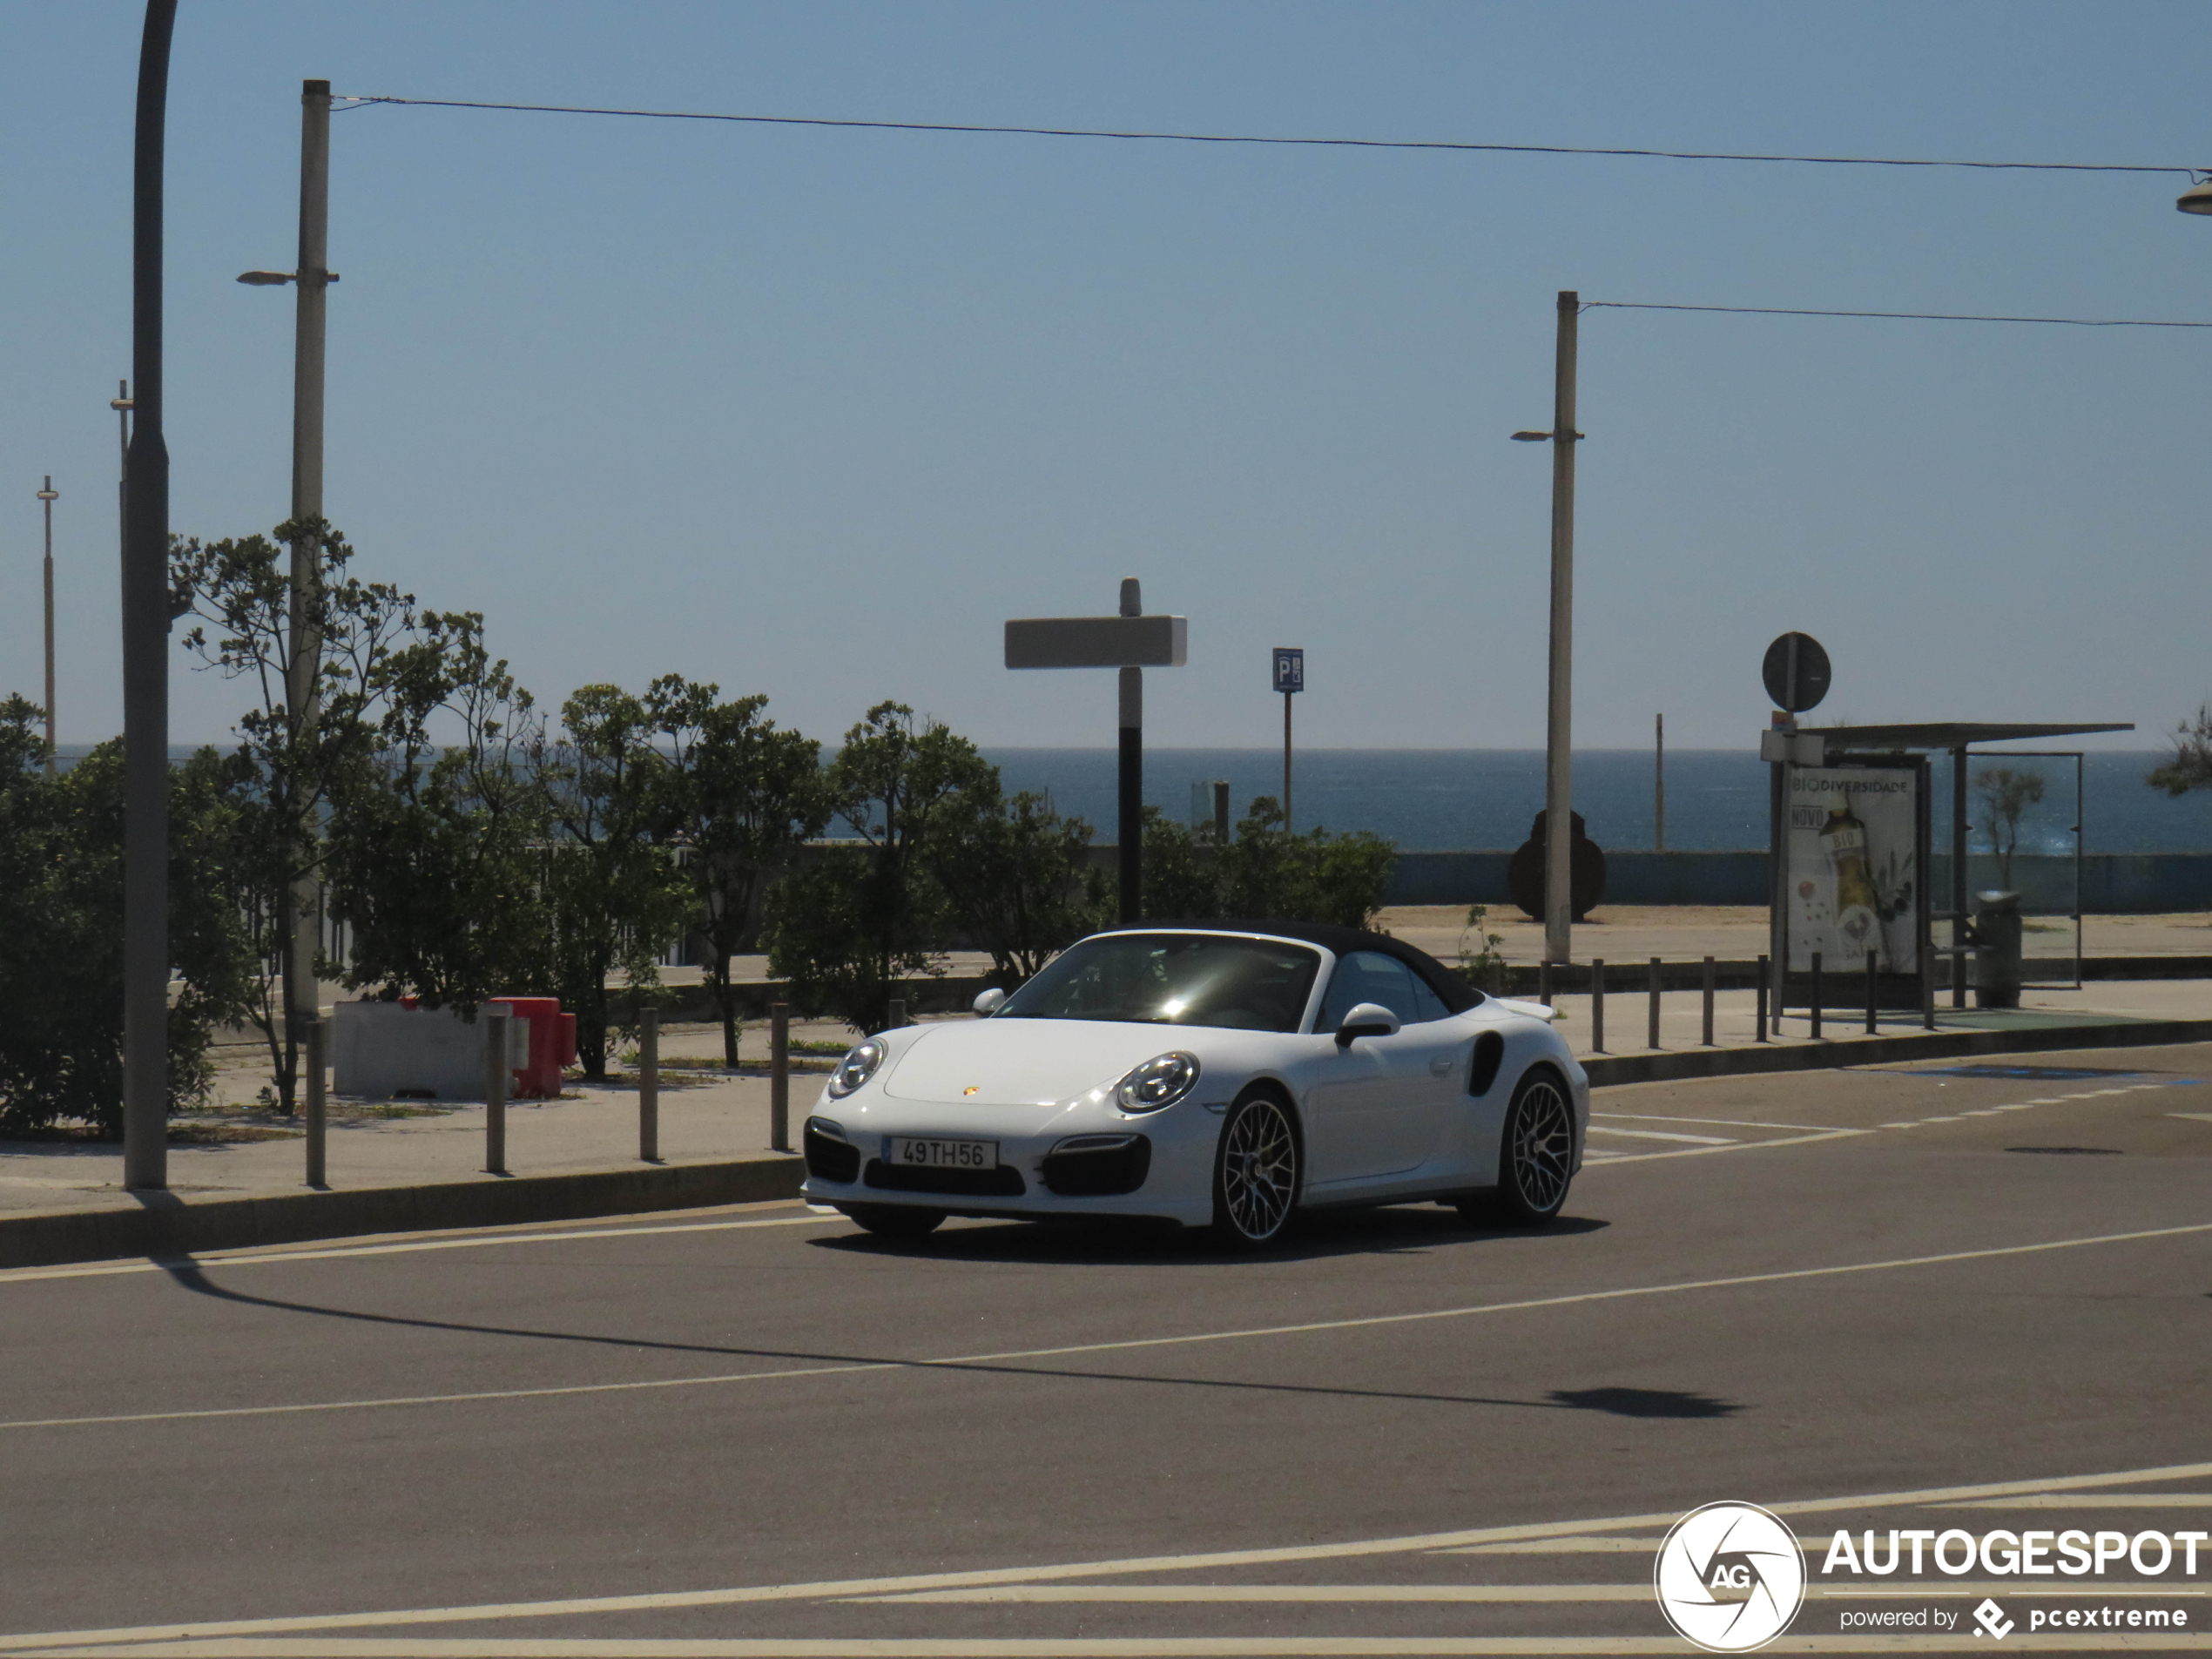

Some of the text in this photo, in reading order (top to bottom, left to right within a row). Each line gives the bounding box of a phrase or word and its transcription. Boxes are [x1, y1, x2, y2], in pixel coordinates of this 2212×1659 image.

[1278, 660, 1291, 683] P
[1791, 778, 1908, 793] BIODIVERSIDADE
[1791, 809, 1824, 826] NOVO
[1832, 832, 1854, 848] BIO
